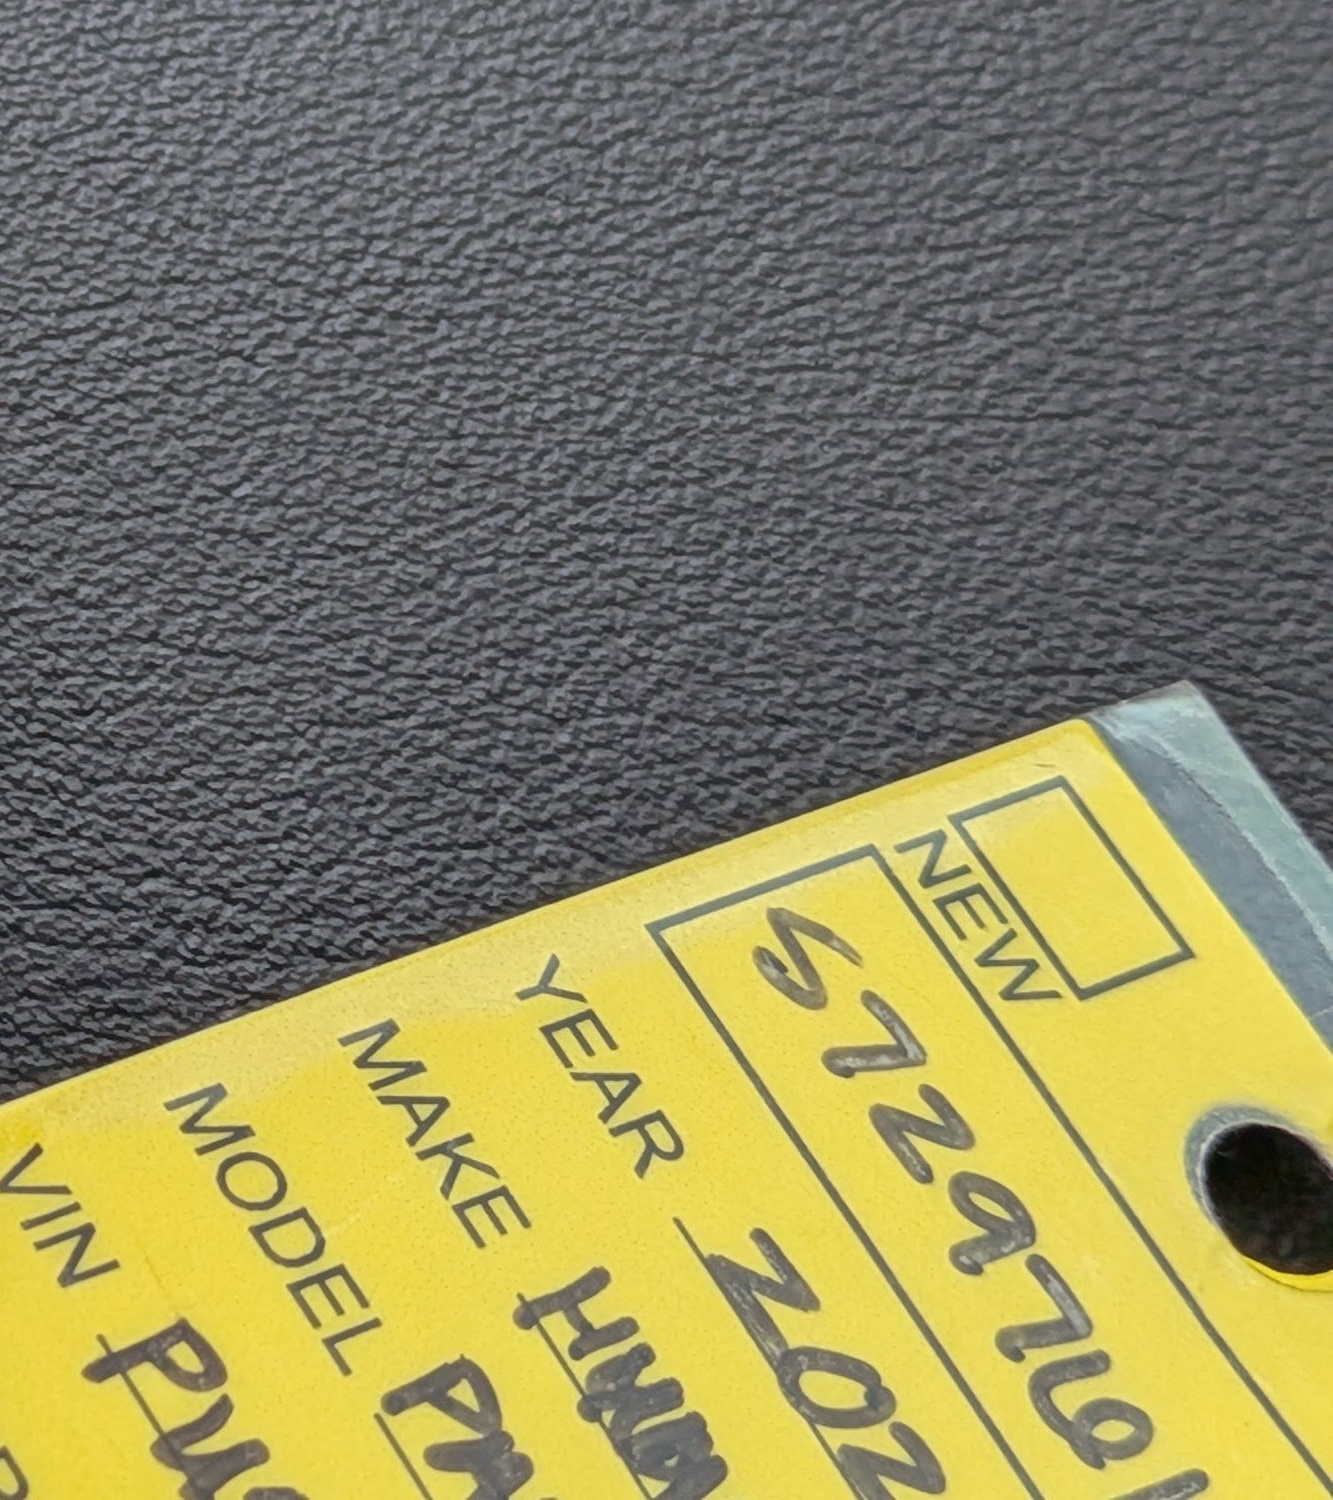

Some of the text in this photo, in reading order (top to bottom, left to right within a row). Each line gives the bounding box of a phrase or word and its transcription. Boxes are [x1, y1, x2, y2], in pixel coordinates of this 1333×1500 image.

[894, 827, 1063, 1005] NEW
[337, 1018, 532, 1249] MAKE
[515, 953, 685, 1179] YEAR
[164, 1082, 383, 1376] MODEL
